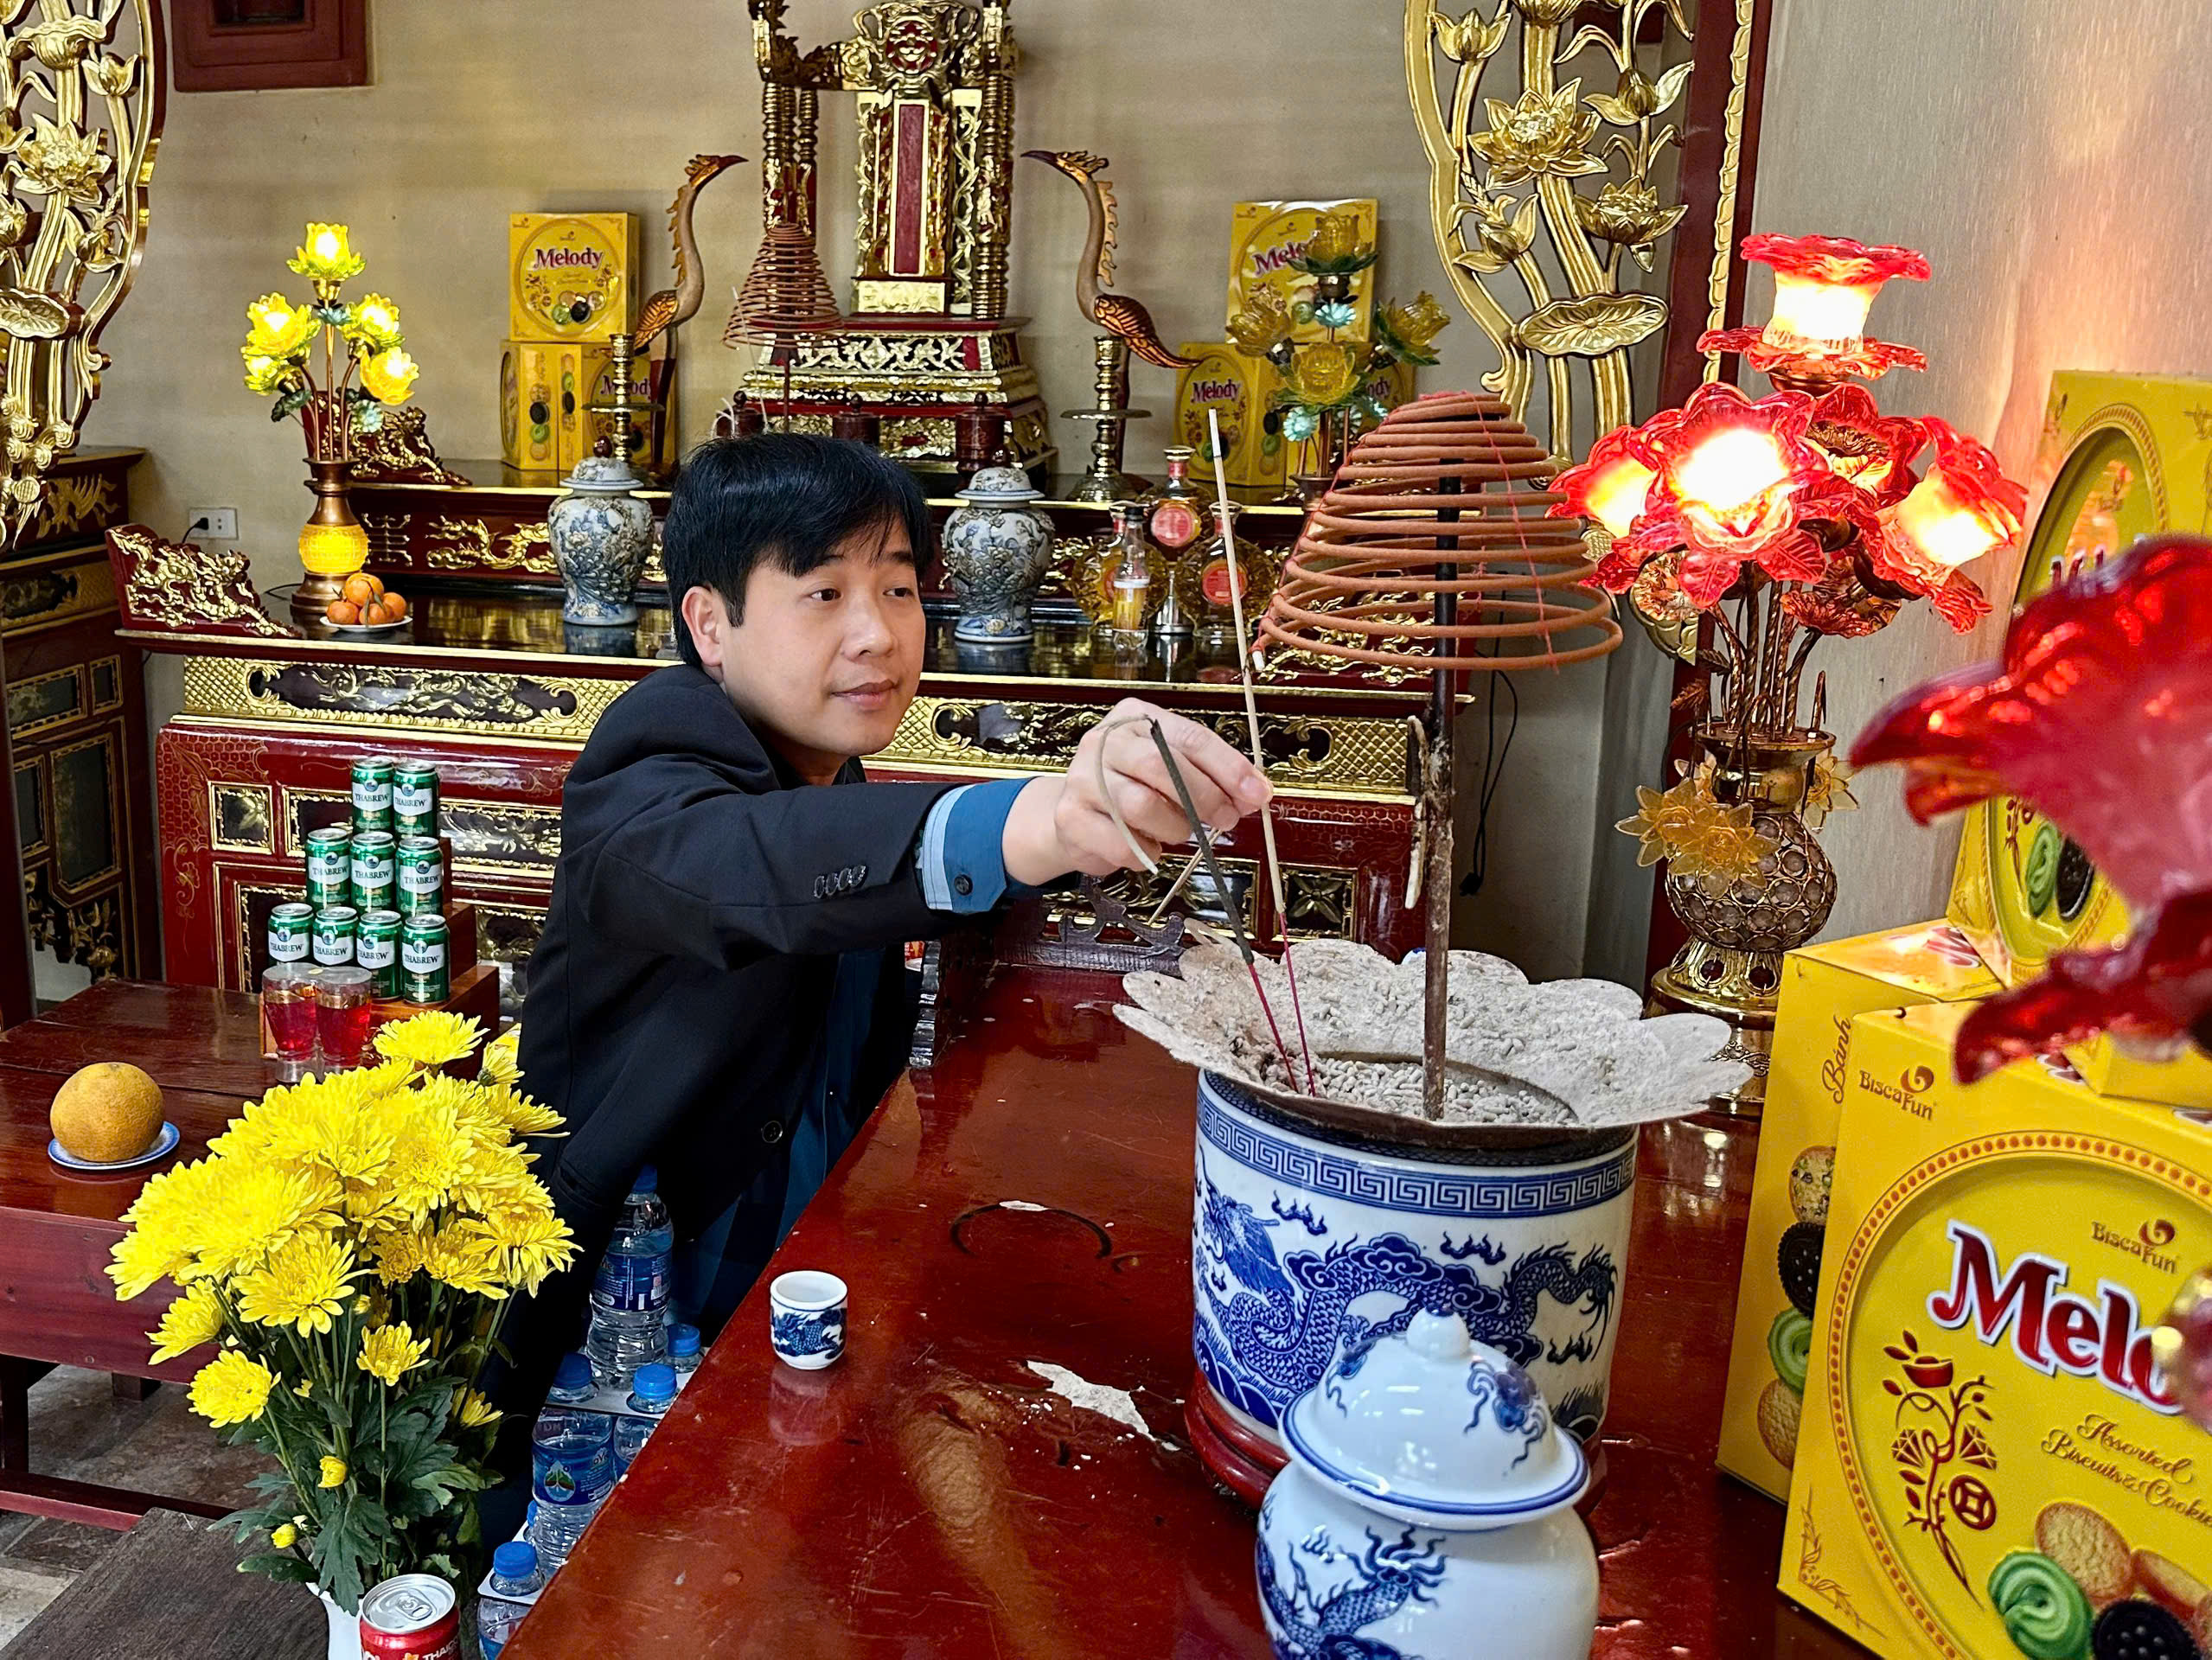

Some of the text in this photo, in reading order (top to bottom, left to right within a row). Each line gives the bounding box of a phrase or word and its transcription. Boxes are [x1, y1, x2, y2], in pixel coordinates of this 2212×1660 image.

[533, 247, 604, 270] Melody
[1191, 379, 1241, 403] Melody
[355, 793, 389, 802] THABREW
[312, 866, 348, 876] THABREW
[355, 870, 390, 879] THABREW
[404, 876, 439, 884] THABREW
[405, 954, 439, 964] THABREW
[1822, 1015, 1851, 1104] Bánh
[2041, 1428, 2122, 1484] Biscuits
[2076, 1414, 2194, 1484] Assorted
